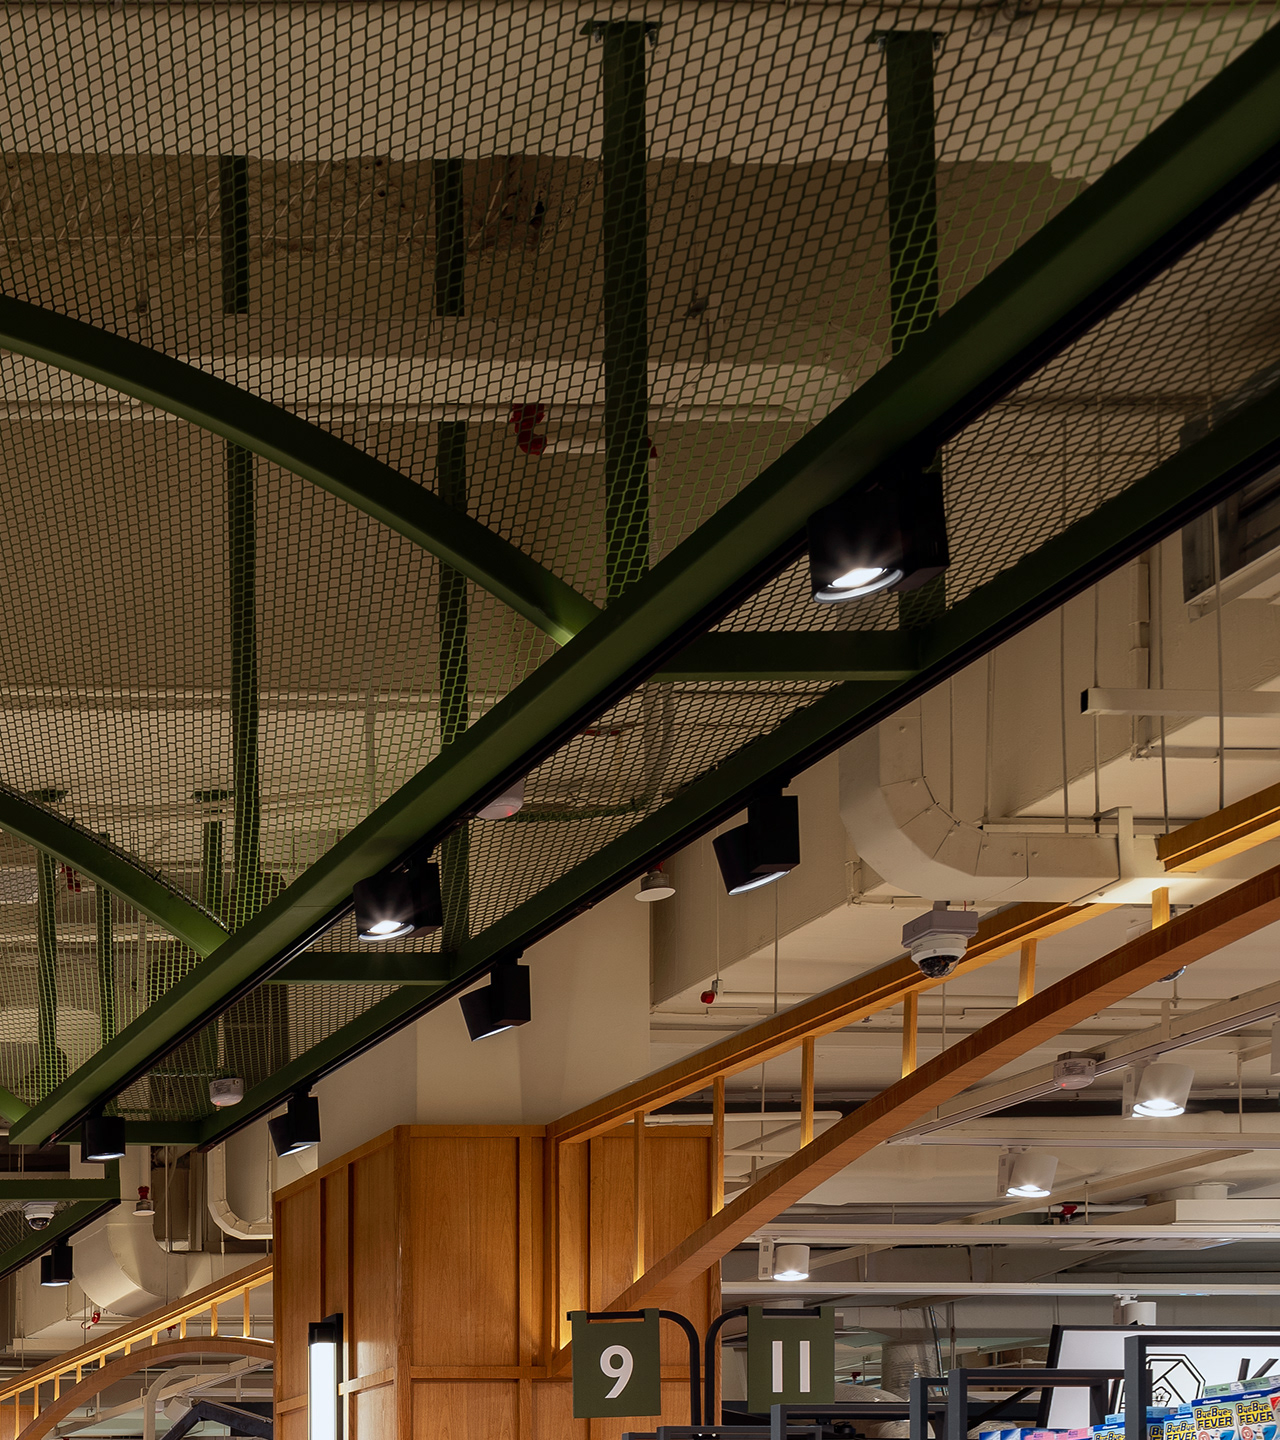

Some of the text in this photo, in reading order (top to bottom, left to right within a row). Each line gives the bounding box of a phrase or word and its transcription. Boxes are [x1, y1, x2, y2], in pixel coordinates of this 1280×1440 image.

[600, 1345, 634, 1398] 9
[772, 1340, 810, 1393] 11
[1197, 1416, 1234, 1430] FEVER
[1239, 1411, 1274, 1425] FEVER
